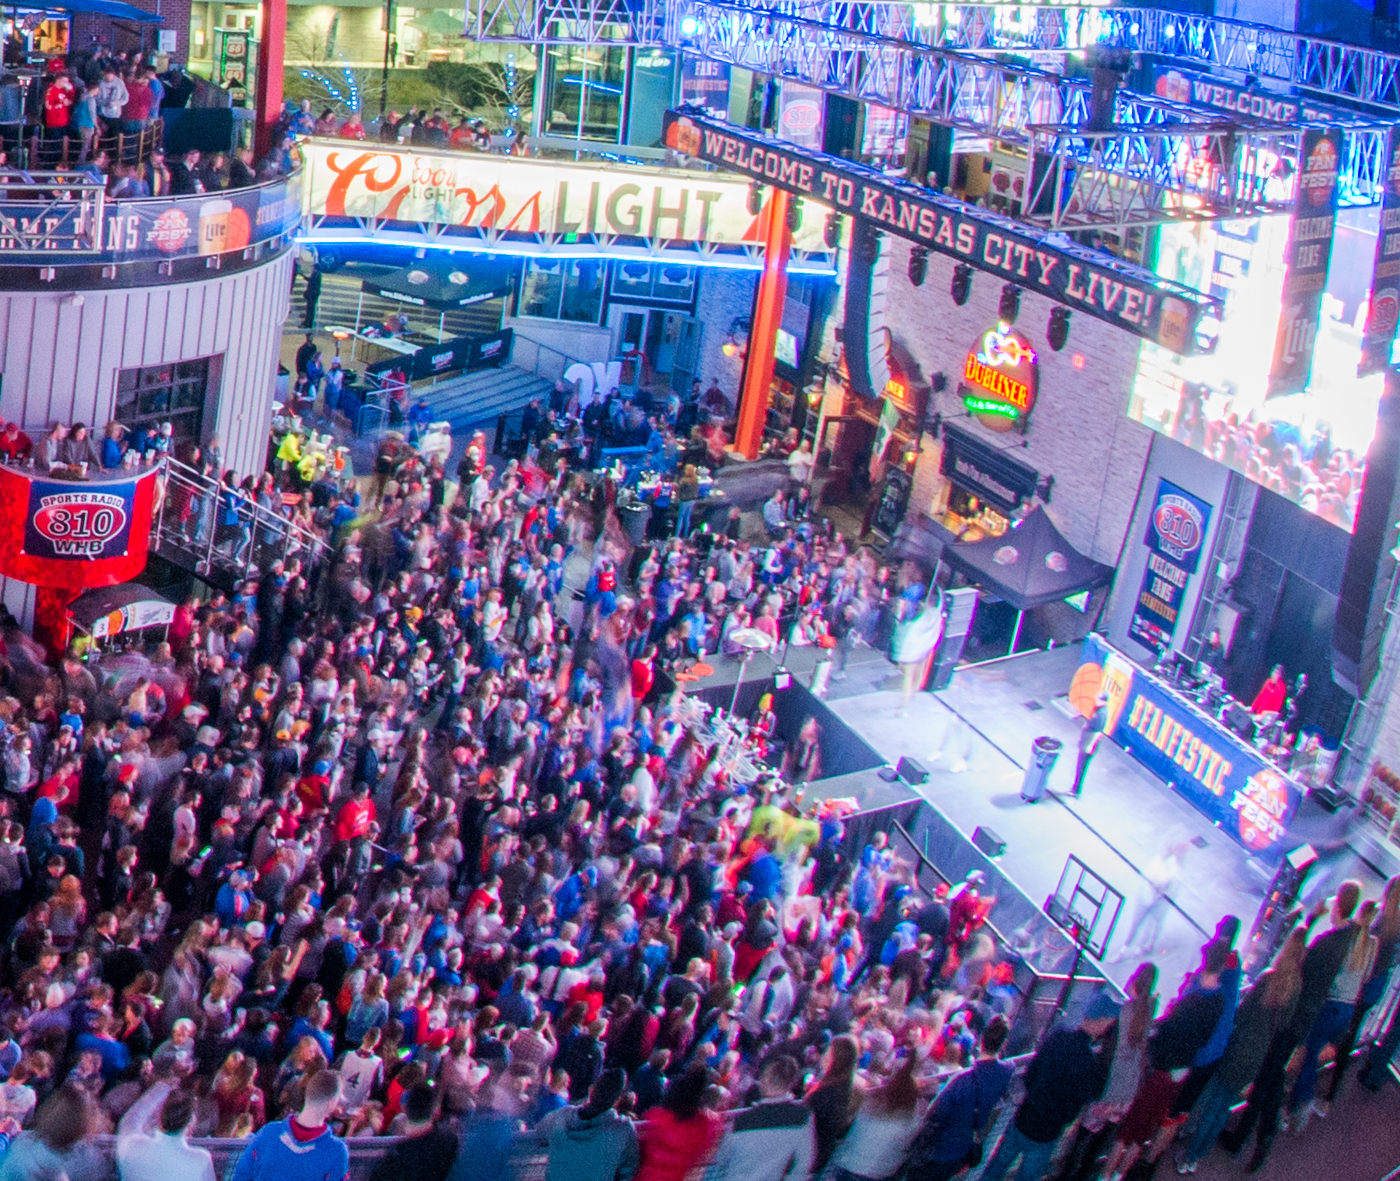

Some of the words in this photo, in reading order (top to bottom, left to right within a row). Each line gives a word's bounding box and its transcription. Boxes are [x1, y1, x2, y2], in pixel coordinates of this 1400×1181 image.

[1193, 80, 1298, 121] WELCOME
[1300, 172, 1338, 189] FEST
[1307, 155, 1336, 170] FAN
[153, 217, 189, 230] FAN
[557, 180, 723, 242] LIGHT
[704, 129, 814, 189] WELCOME
[820, 173, 855, 206] TO
[860, 186, 975, 255] KANSAS
[983, 232, 1060, 286] CITY
[1065, 264, 1155, 328] LIVE!
[146, 228, 193, 242] FEST
[965, 351, 1029, 409] DUBLINER
[42, 493, 88, 507] SPORTS
[90, 493, 123, 508] RADIO
[47, 508, 114, 537] 810
[1159, 506, 1196, 546] 810
[54, 540, 103, 554] WHB
[1127, 693, 1233, 797] #FANFESTKC
[1229, 789, 1287, 842] FEST
[1242, 775, 1289, 821] FAN
